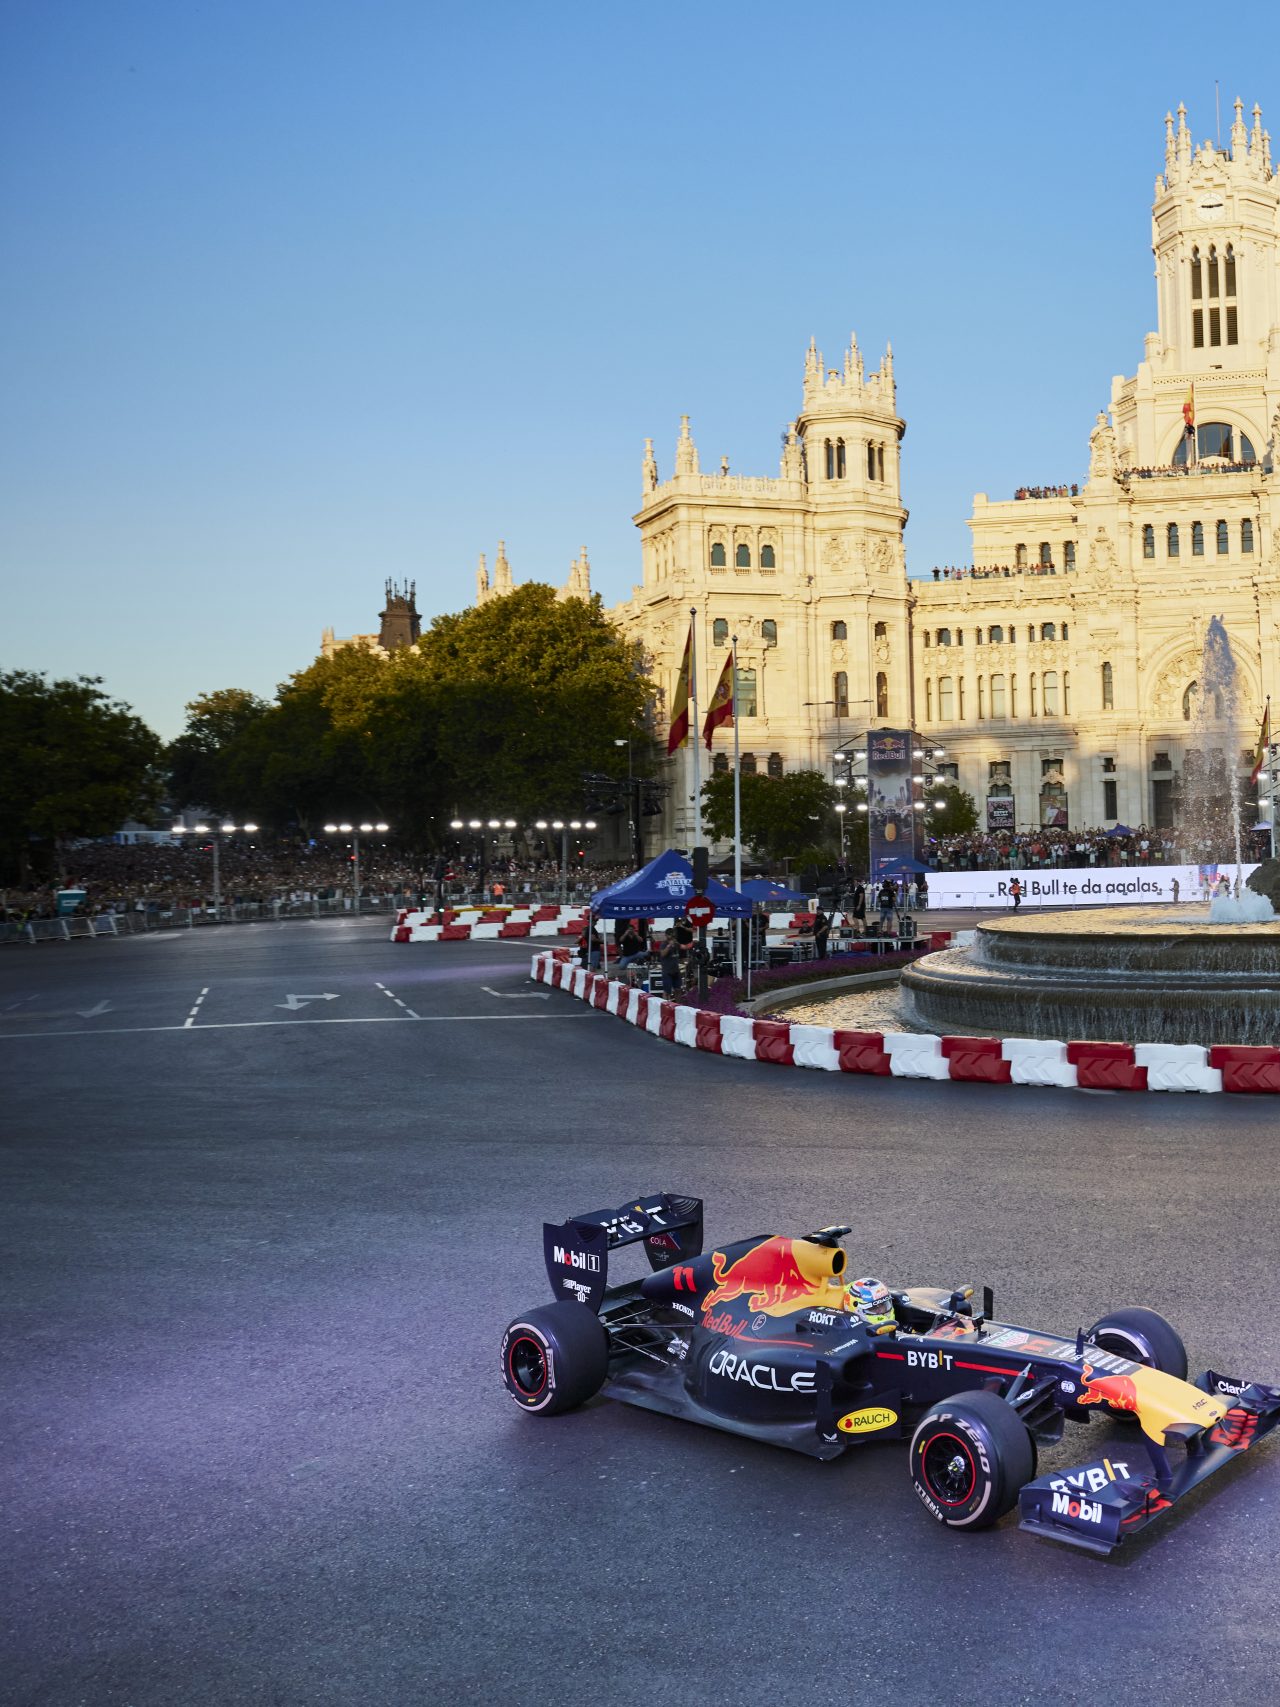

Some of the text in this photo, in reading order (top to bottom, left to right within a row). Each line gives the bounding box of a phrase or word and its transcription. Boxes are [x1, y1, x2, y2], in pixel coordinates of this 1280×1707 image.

[873, 750, 905, 760] Red Bull
[1032, 879, 1059, 896] Bull
[1063, 879, 1077, 895] te
[1081, 878, 1101, 894] da
[554, 1246, 586, 1269] Mobil
[673, 1266, 696, 1292] 11
[672, 1302, 695, 1318] HONDA
[809, 1312, 836, 1326] ROKT
[907, 1350, 953, 1371] BYBIT
[709, 1350, 818, 1393] ORACLE
[853, 1413, 890, 1427] RAUCH
[955, 1418, 991, 1474] ZERO
[1052, 1492, 1103, 1524] Mobil
